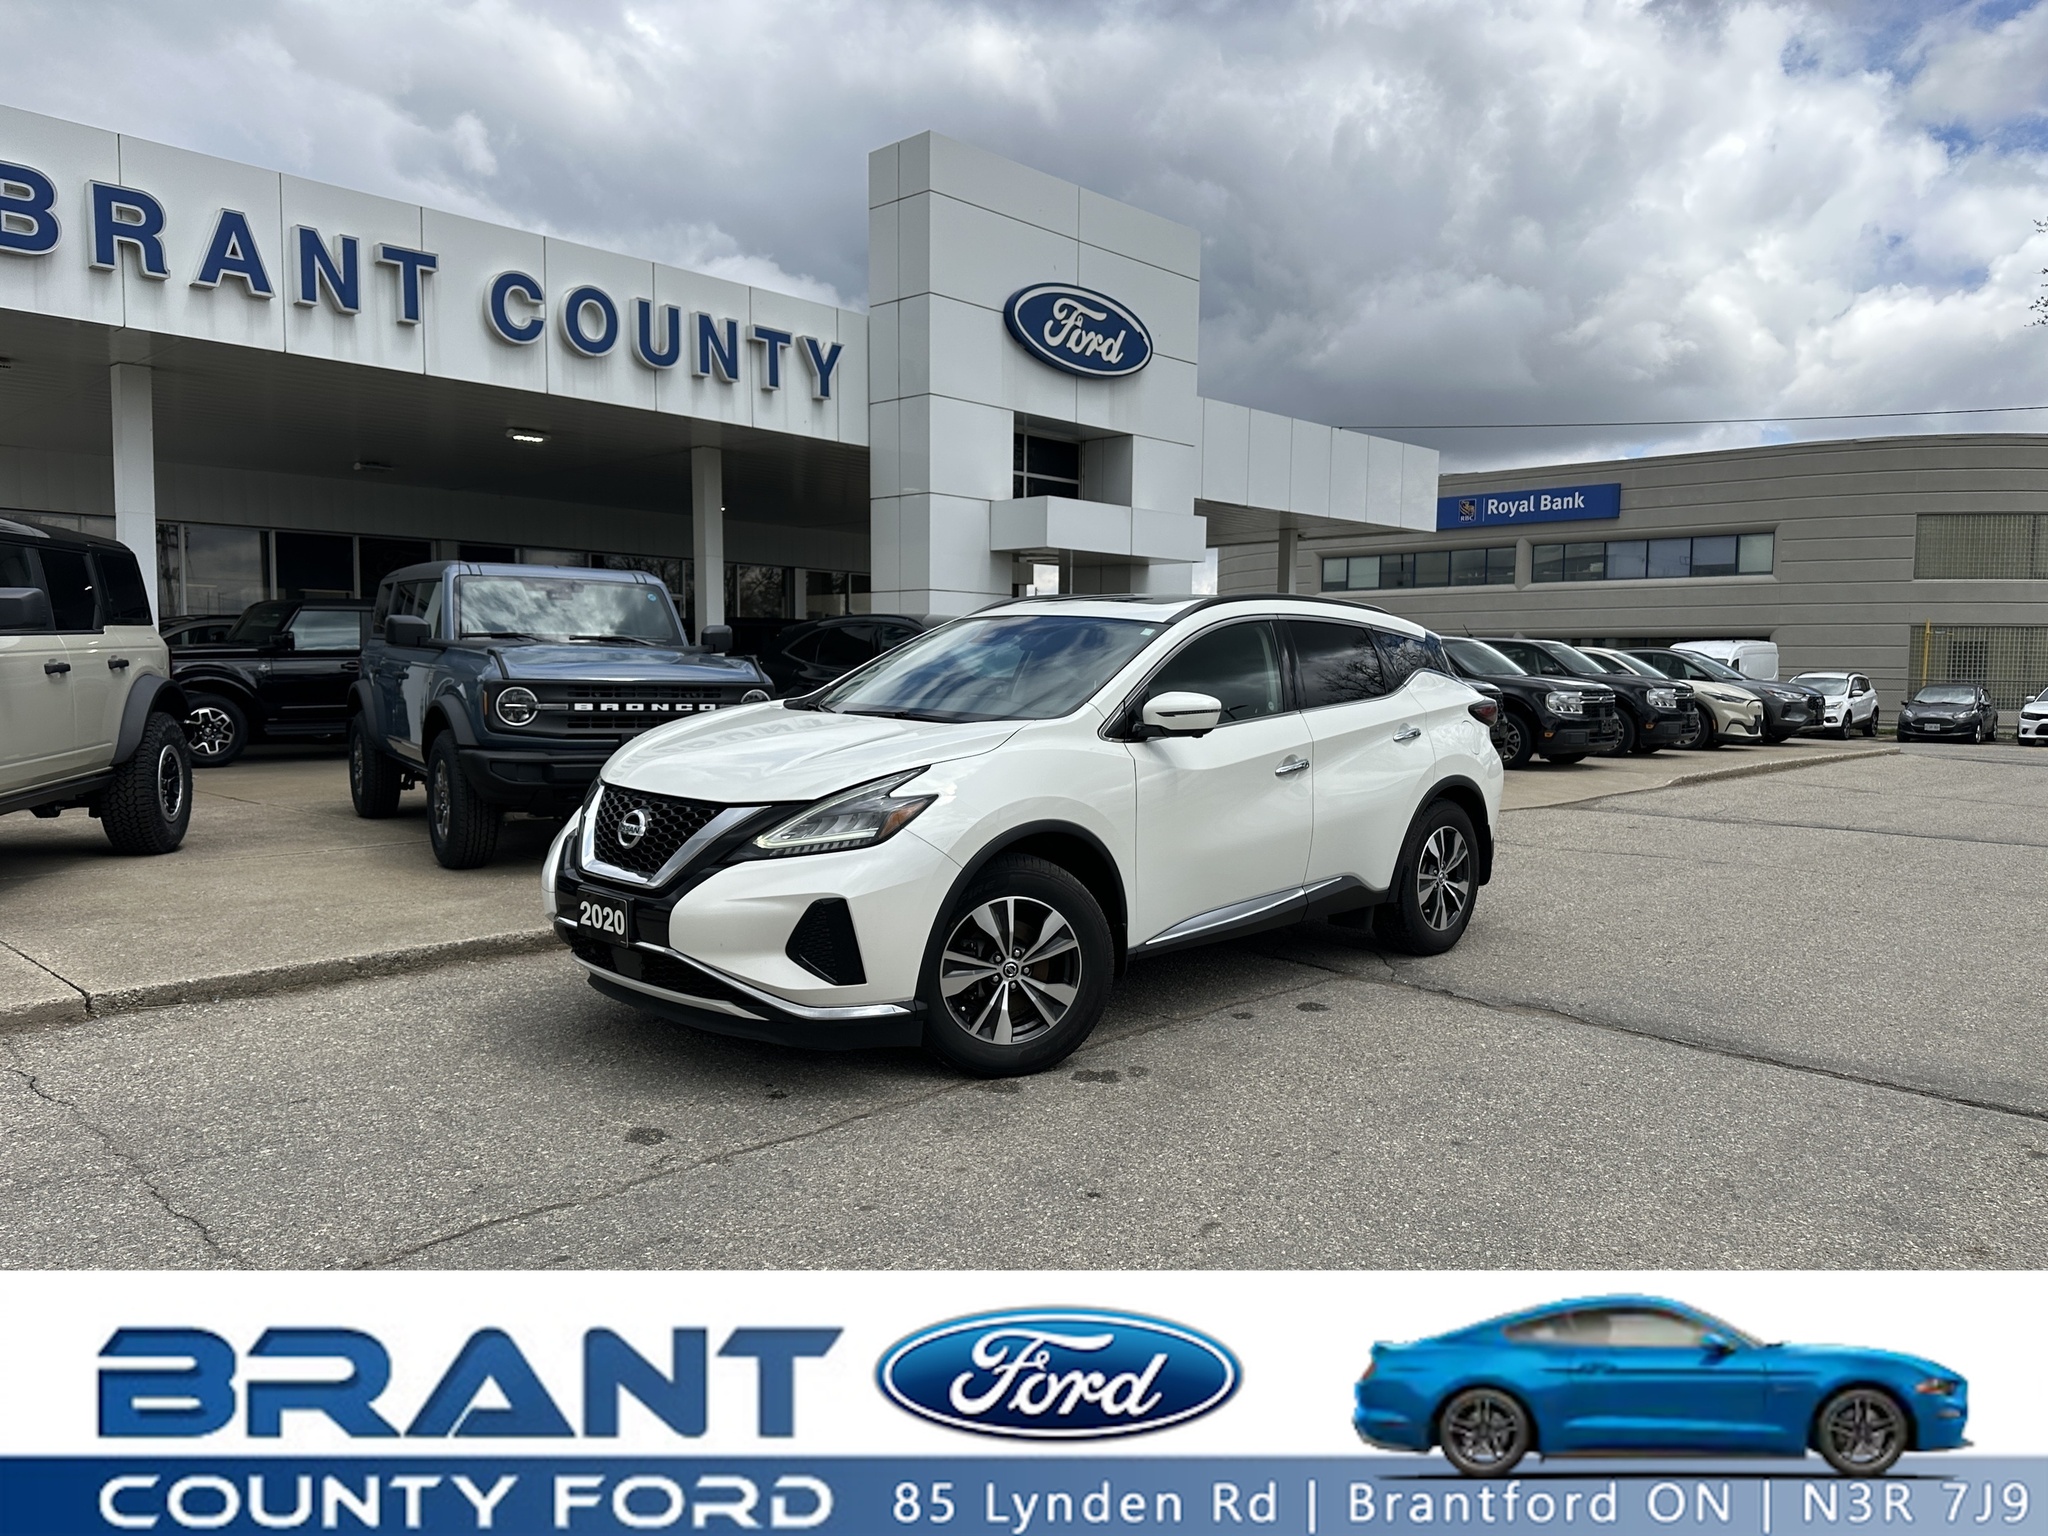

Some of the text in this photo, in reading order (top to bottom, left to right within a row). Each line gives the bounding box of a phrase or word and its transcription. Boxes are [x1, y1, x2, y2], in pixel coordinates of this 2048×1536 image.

[0, 159, 844, 400] BRANT COUNTY
[1043, 297, 1127, 364] Ford
[1487, 492, 1585, 518] Royal Bank
[574, 703, 717, 711] BRONCO
[579, 901, 625, 936] 2020
